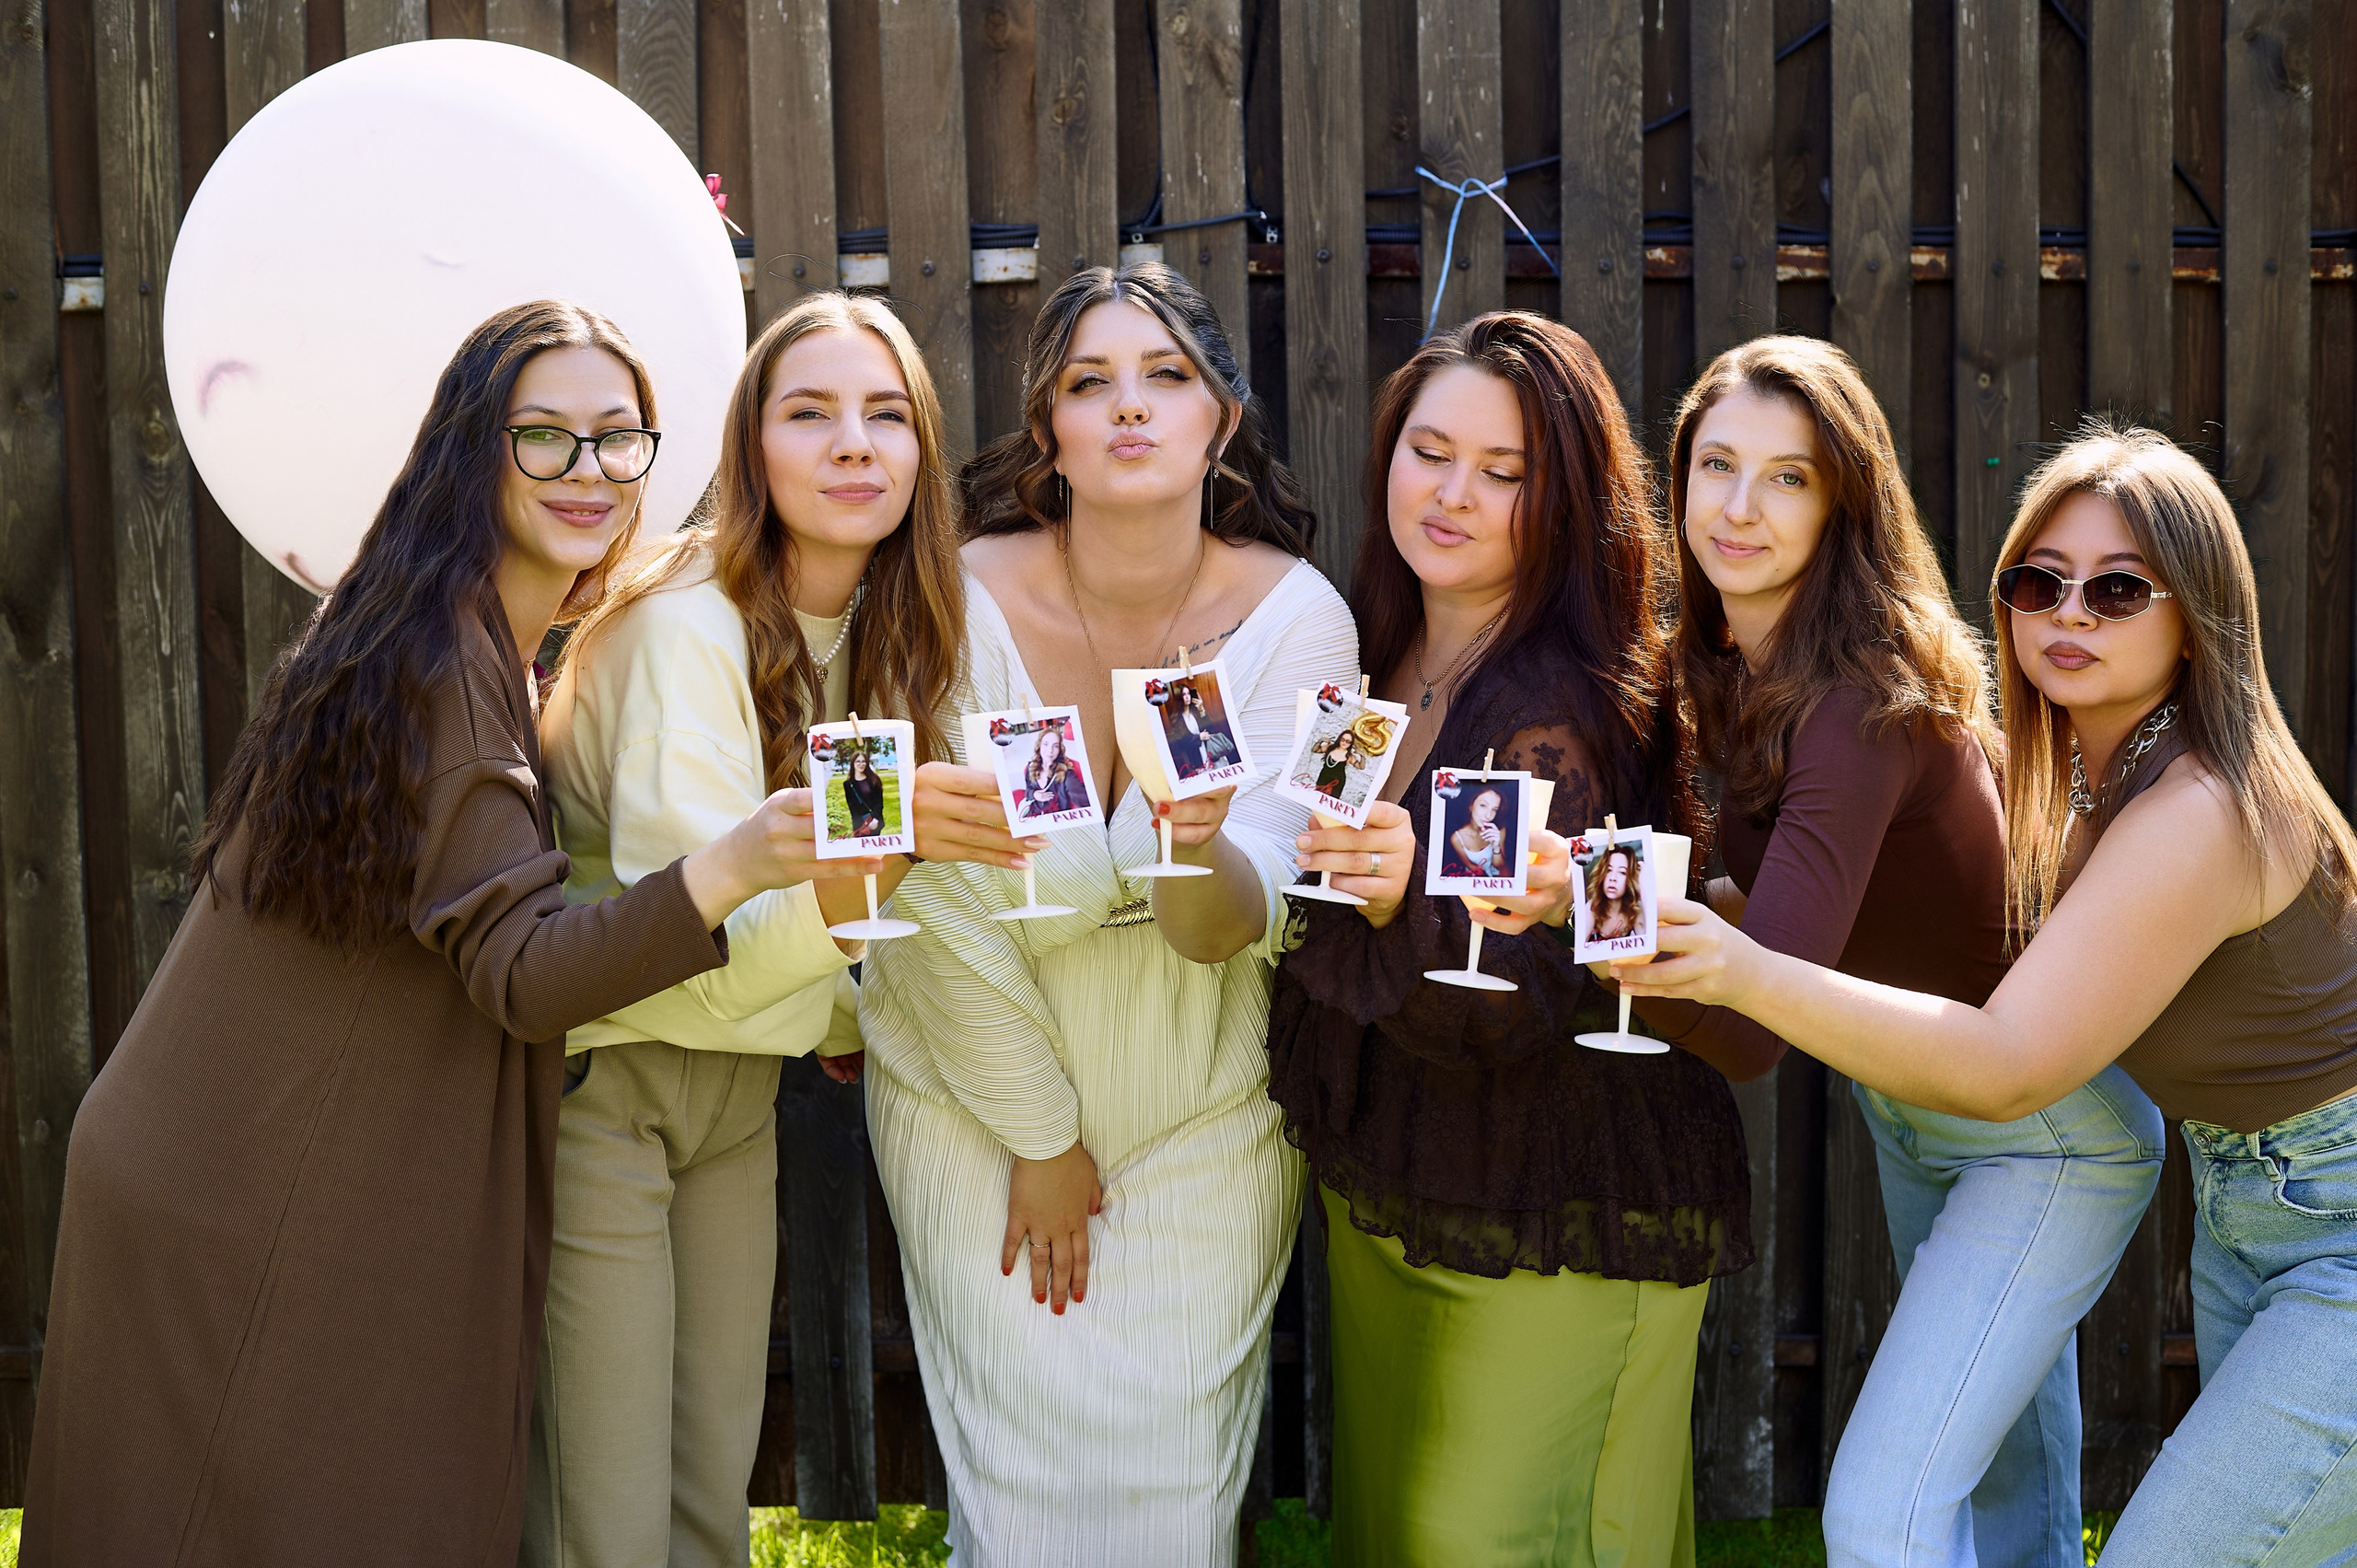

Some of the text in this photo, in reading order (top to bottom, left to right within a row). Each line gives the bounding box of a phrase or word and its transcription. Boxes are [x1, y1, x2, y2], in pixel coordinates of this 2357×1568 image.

[1189, 644, 1200, 655] de
[1208, 764, 1245, 783] PARTY
[1318, 794, 1356, 819] PARTY
[1052, 808, 1093, 822] PARTY
[861, 835, 902, 848] PARTY
[1472, 878, 1514, 889] PARTY
[1611, 936, 1645, 951] PARTY
